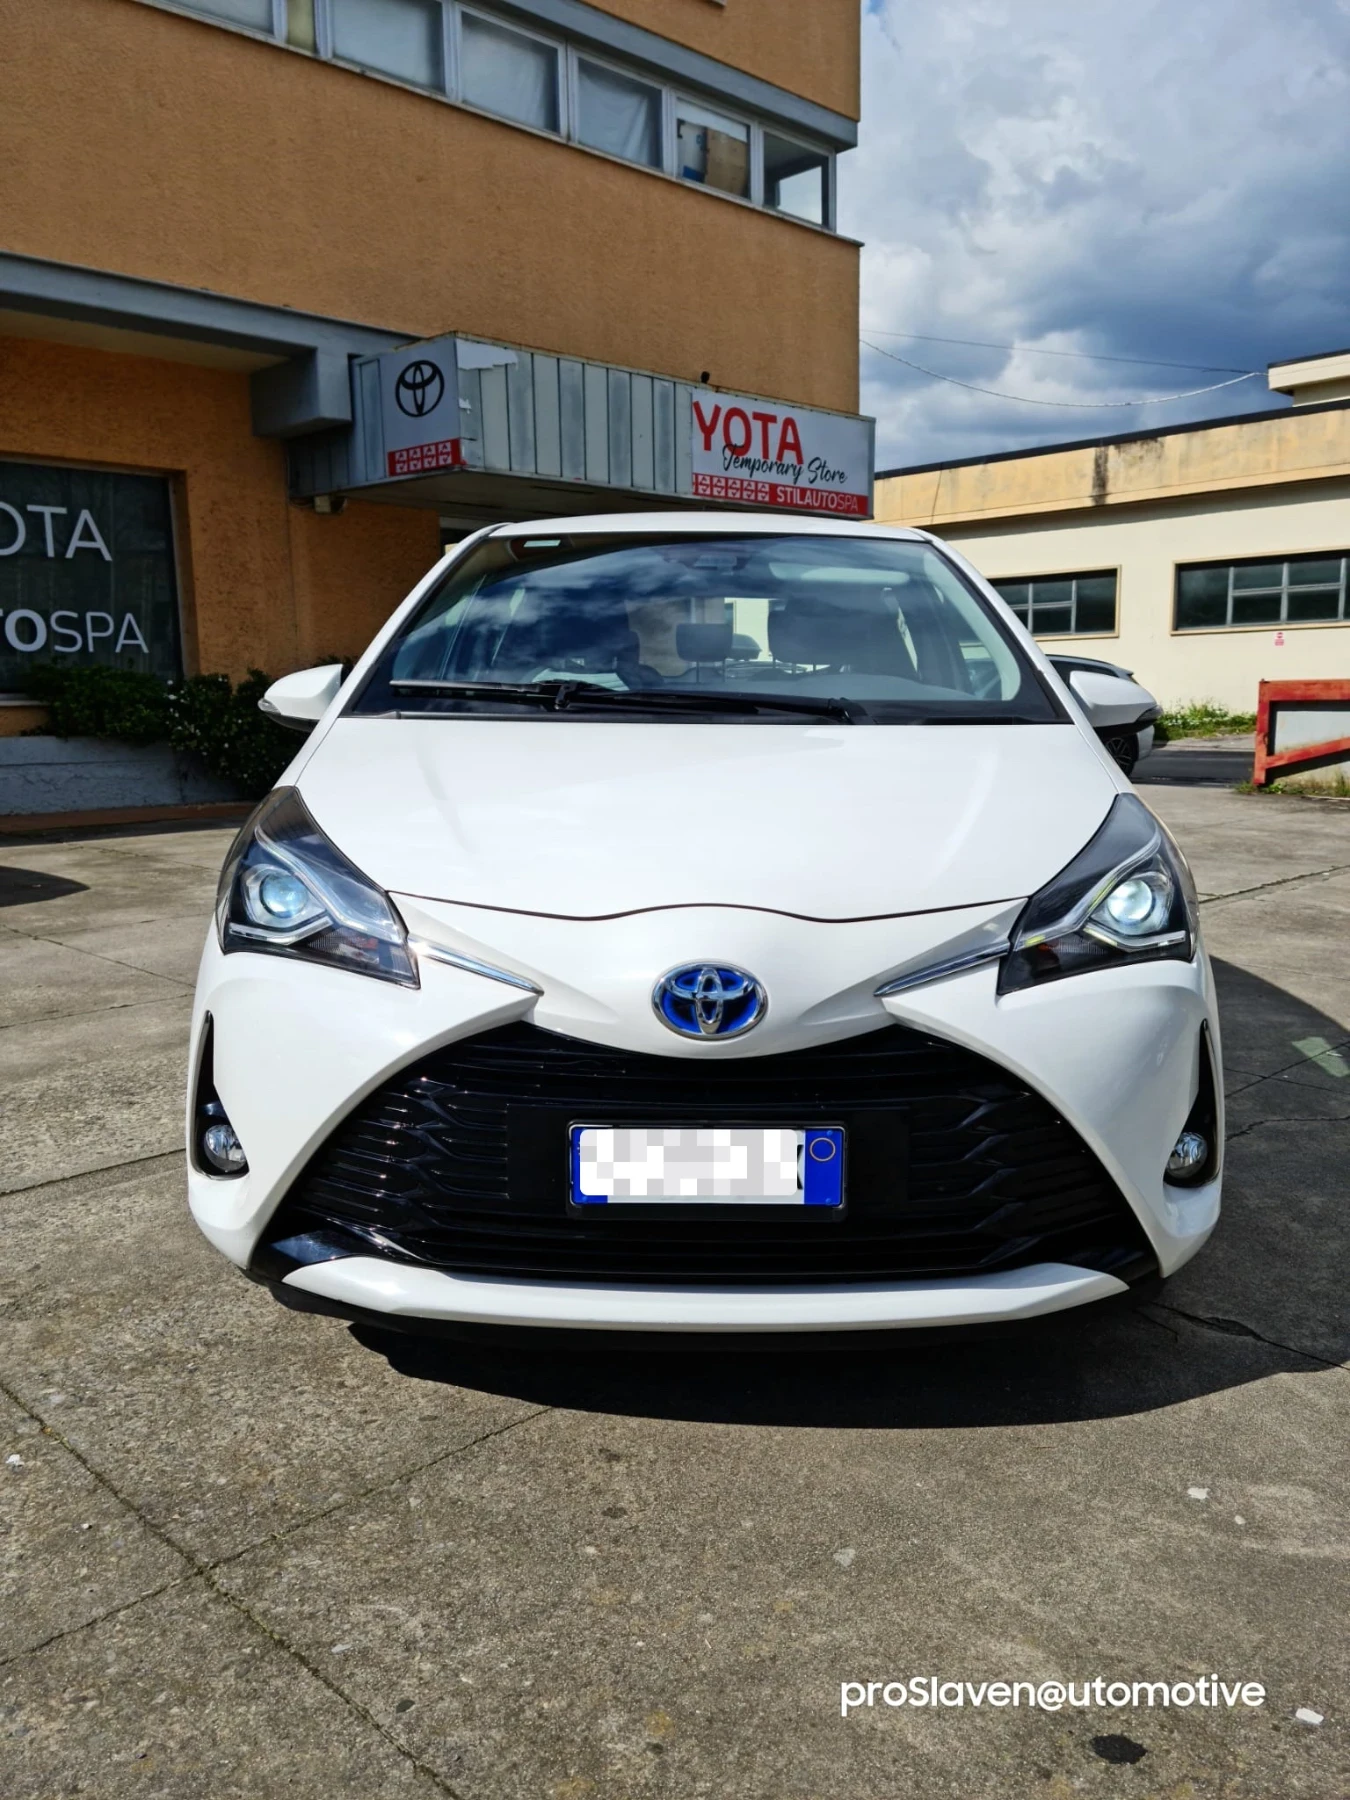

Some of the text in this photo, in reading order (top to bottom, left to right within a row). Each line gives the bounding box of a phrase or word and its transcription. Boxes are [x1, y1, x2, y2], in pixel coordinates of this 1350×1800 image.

[693, 401, 804, 465] YOTA
[722, 444, 847, 485] Temporary Store
[776, 486, 858, 512] STILAUTOSPA
[0, 609, 150, 654] OSPA
